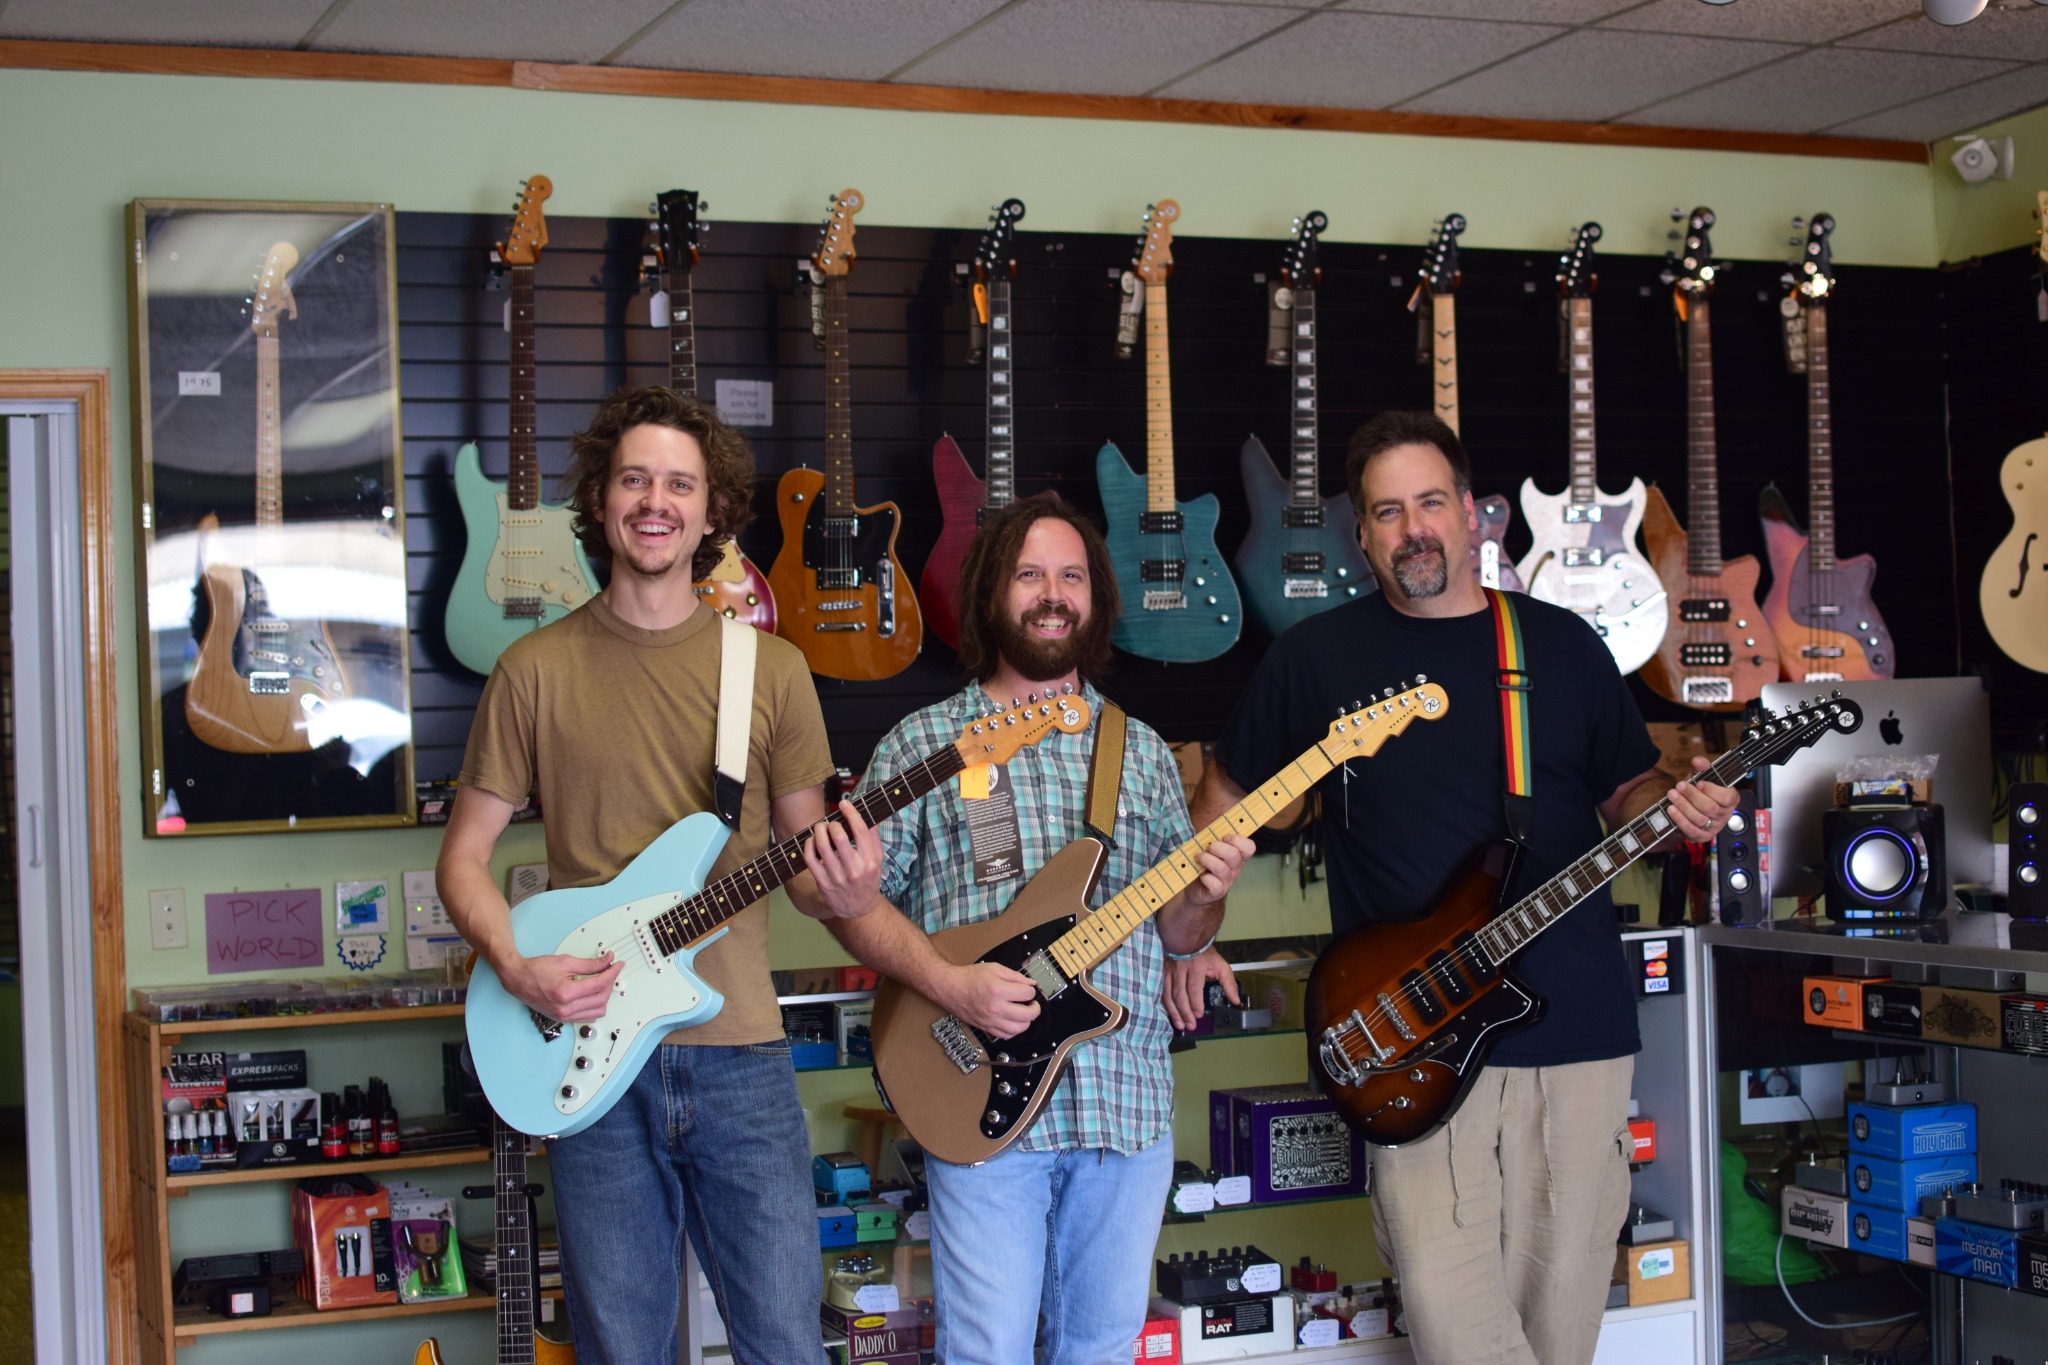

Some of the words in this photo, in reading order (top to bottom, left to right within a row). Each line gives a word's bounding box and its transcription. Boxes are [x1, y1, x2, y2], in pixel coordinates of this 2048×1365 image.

[730, 388, 758, 397] Please
[226, 899, 309, 927] PICK
[215, 935, 318, 962] WORLD
[1647, 980, 1668, 990] VISA
[1913, 1135, 1938, 1154] HOLY
[1961, 1240, 2004, 1261] MEMORY
[1973, 1257, 2002, 1276] MAN
[1206, 1323, 1233, 1335] RAT
[854, 1334, 886, 1357] DADDY
